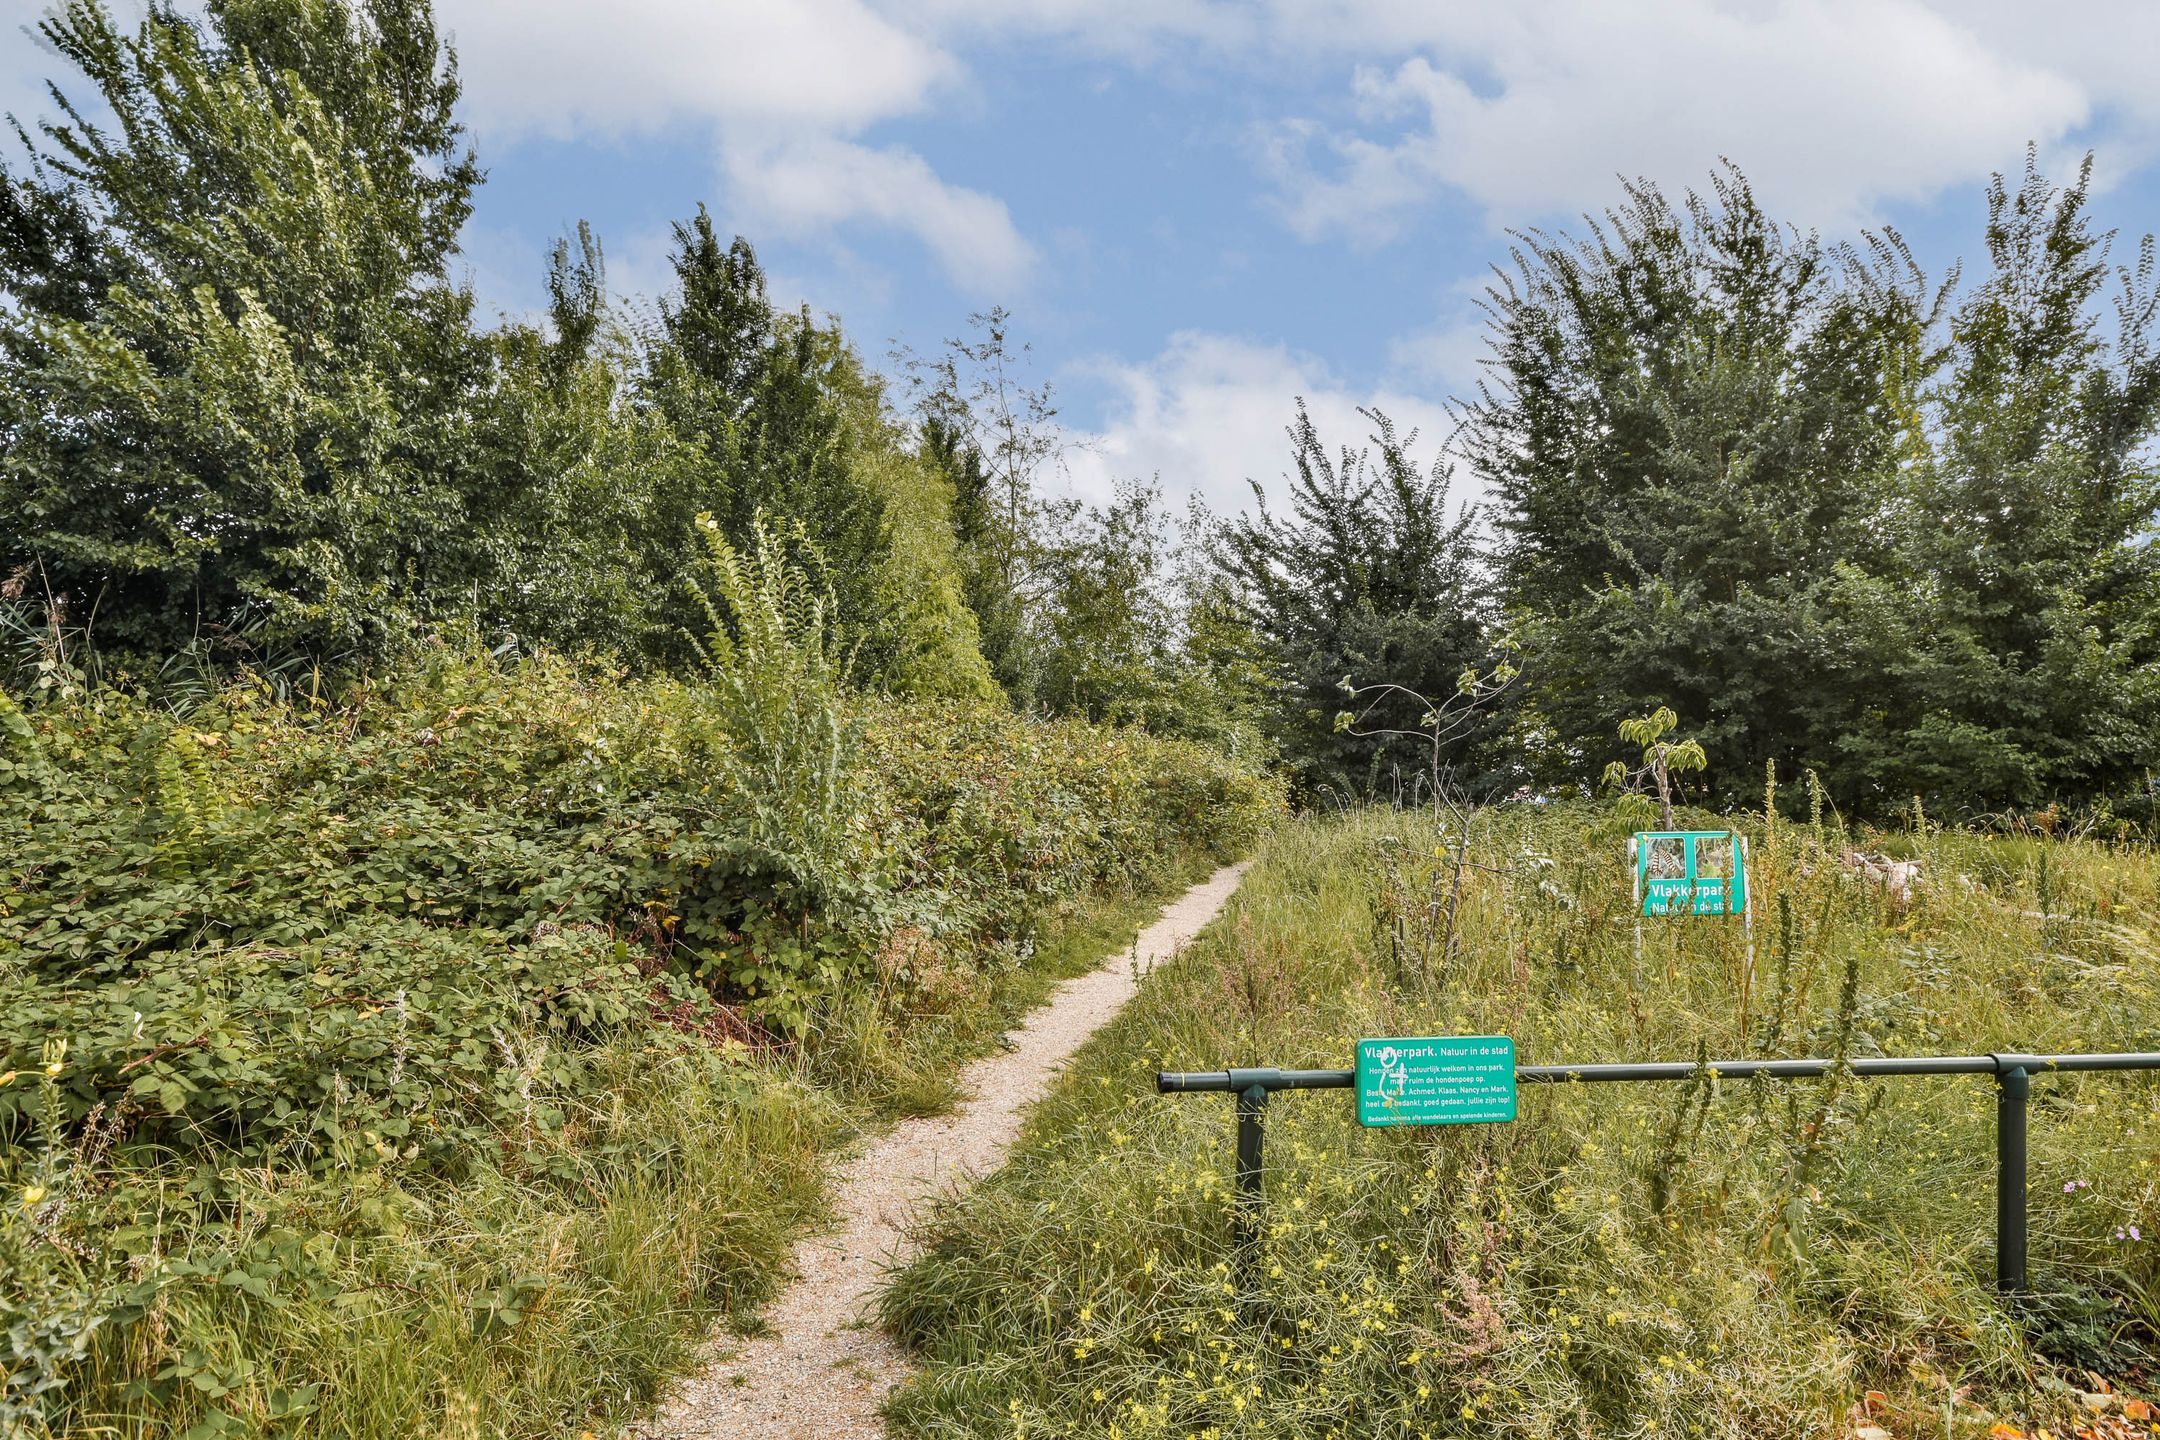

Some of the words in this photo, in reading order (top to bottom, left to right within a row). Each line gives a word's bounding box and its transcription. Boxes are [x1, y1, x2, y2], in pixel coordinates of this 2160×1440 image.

[1440, 1047, 1468, 1056] Natuur
[1470, 1046, 1478, 1055] in
[1479, 1046, 1490, 1055] de
[1491, 1046, 1509, 1055] stad
[1408, 1065, 1440, 1075] natuurlijk
[1441, 1064, 1467, 1072] welkom
[1467, 1064, 1475, 1072] in
[1475, 1064, 1487, 1072] ons
[1408, 1076, 1425, 1084] ruim
[1425, 1076, 1434, 1084] de
[1435, 1075, 1475, 1084] hondenpoep
[1459, 1085, 1480, 1095] Nancy
[1365, 1100, 1380, 1108] heel
[1423, 1098, 1440, 1107] goed
[1467, 1096, 1484, 1106] jullie
[1485, 1096, 1497, 1105] zijn
[1497, 1095, 1511, 1105] top!
[1422, 1113, 1452, 1121] wandelaars
[1460, 1112, 1483, 1120] spelende
